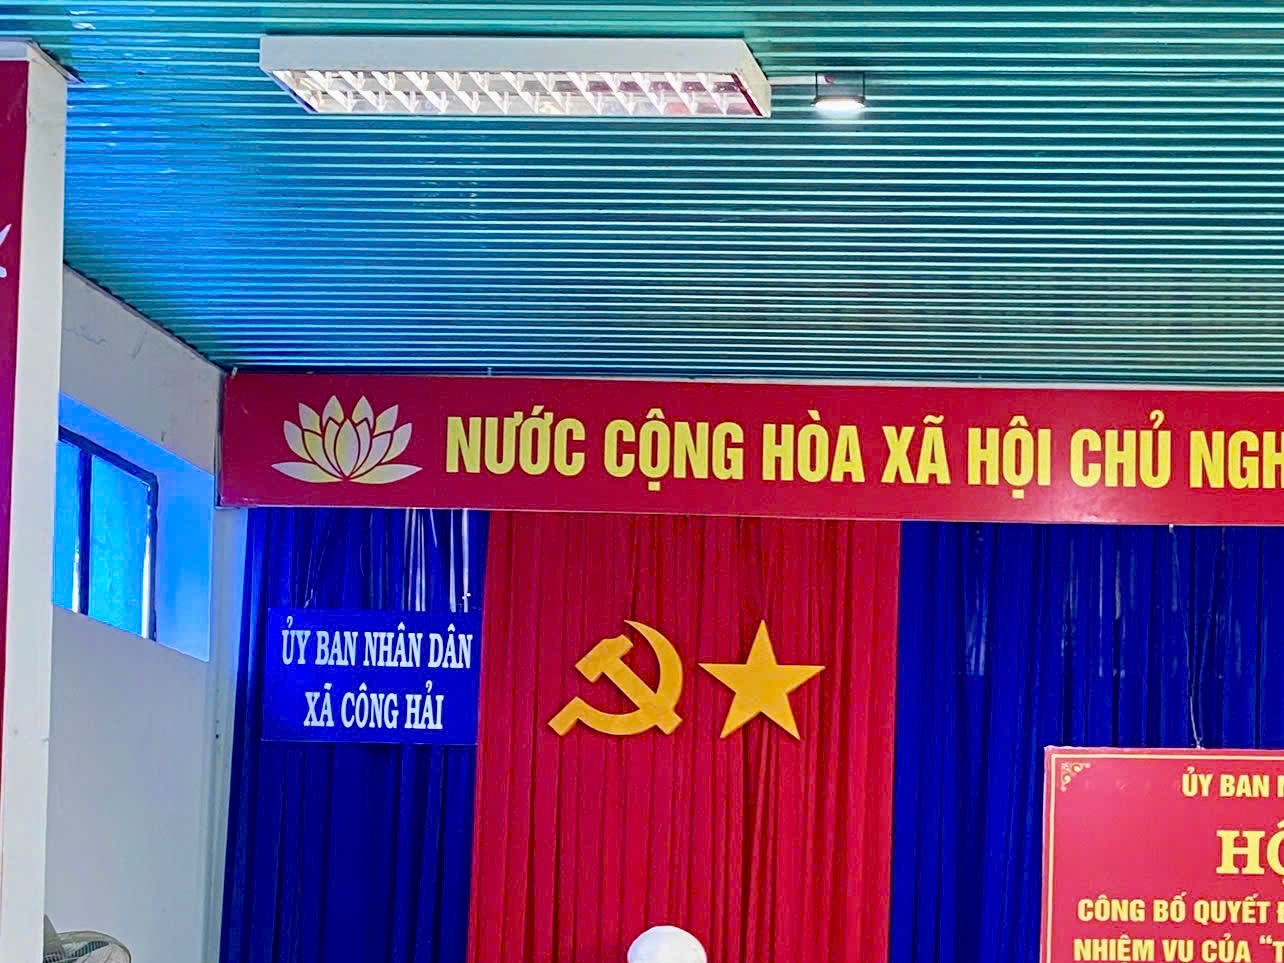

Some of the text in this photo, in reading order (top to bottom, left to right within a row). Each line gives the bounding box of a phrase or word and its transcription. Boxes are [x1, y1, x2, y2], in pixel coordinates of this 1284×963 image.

[446, 406, 585, 477] NƯỚC
[604, 409, 744, 491] CỘNG
[762, 410, 865, 483] HÒA
[881, 415, 950, 484] XÃ
[967, 415, 1052, 499] HỘI
[1070, 409, 1171, 487] CHỦ
[281, 615, 474, 669] ỦY BAN NHÂN DÂN
[303, 680, 445, 730] XÃ CÔNG HẢI
[1182, 766, 1213, 797] ỦY
[1219, 774, 1270, 798] BAN
[1077, 894, 1146, 922] CÔNG
[1153, 891, 1187, 923] BỐ
[1193, 893, 1271, 926] QUYẾT
[1201, 932, 1252, 963] CỦA
